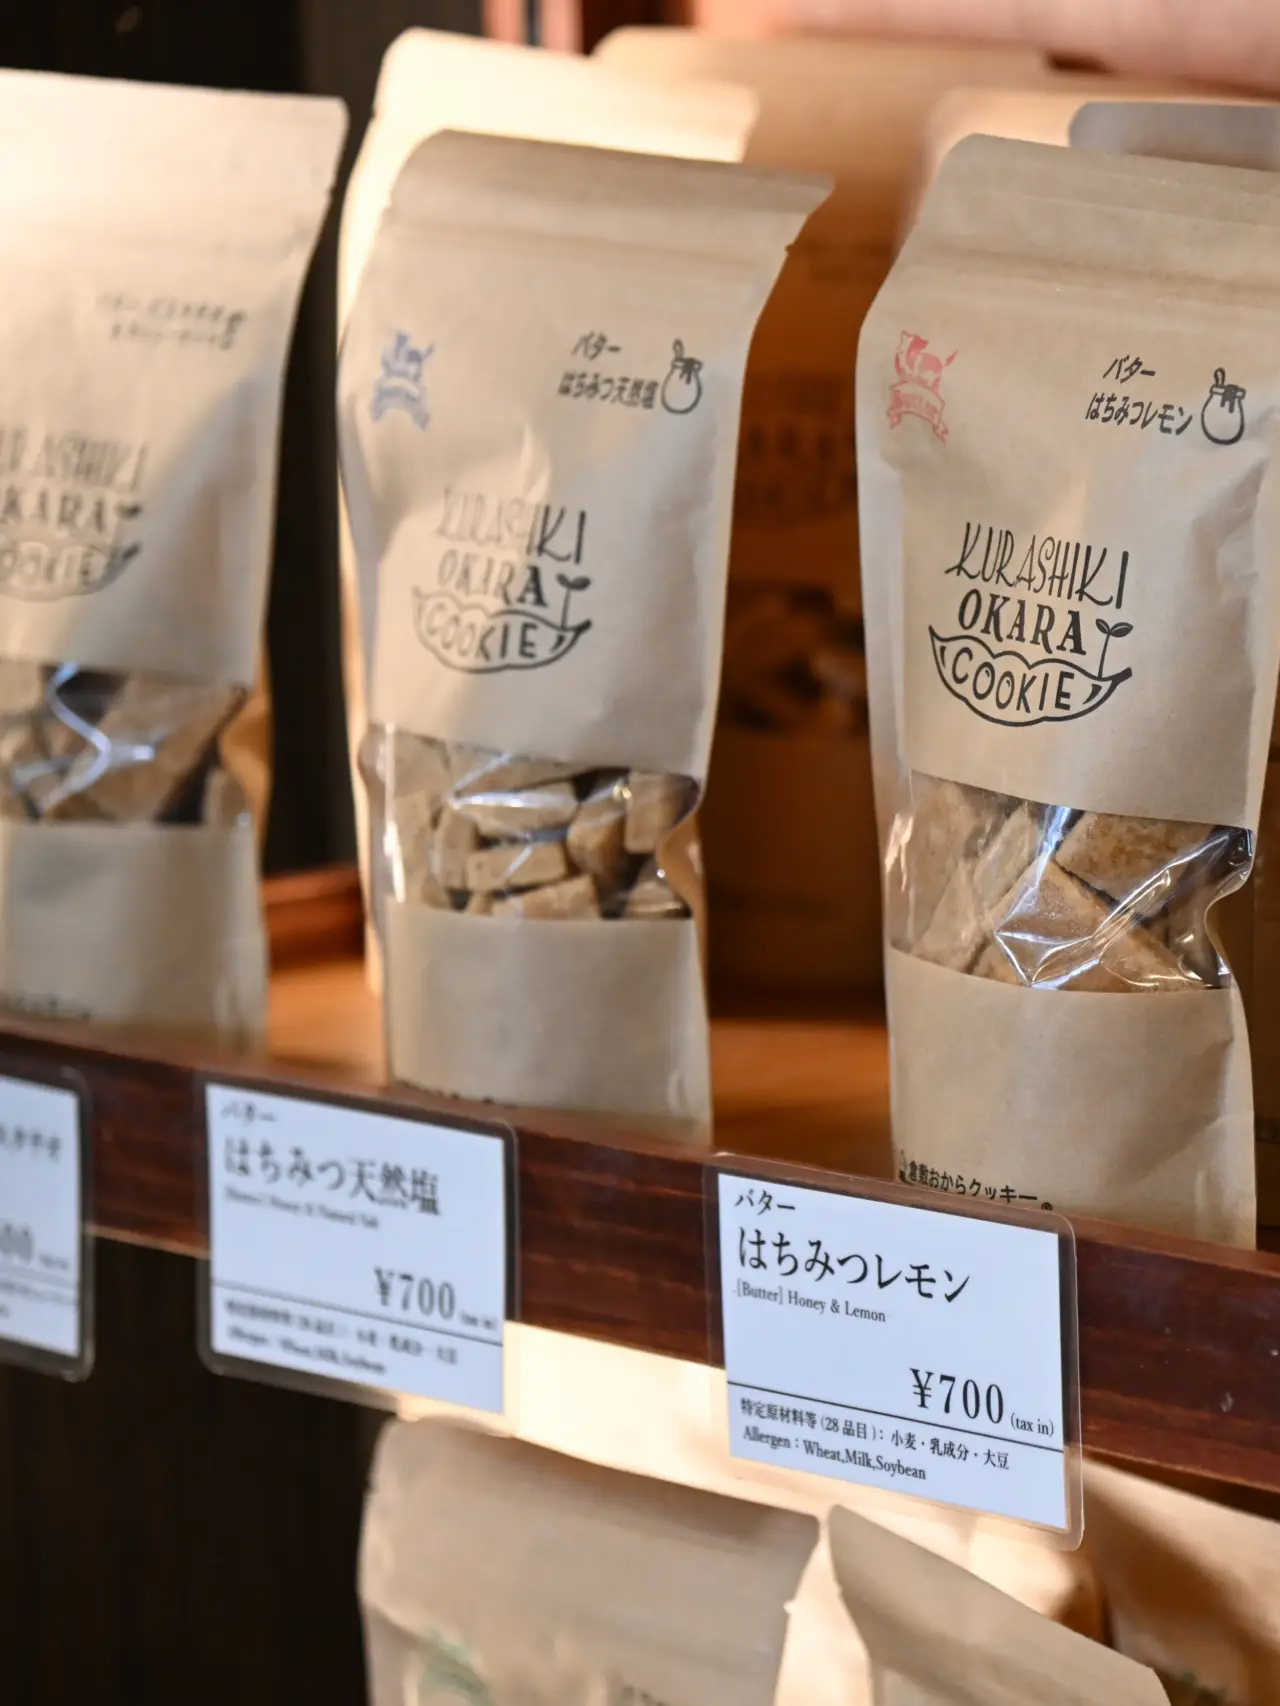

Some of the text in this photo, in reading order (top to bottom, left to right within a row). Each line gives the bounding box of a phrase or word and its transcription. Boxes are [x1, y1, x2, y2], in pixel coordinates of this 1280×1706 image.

[1103, 354, 1156, 384] バター
[1085, 391, 1194, 435] はちみつレモン
[945, 522, 1129, 609] KURASHIKI
[958, 589, 1087, 655] OKARA
[952, 647, 1074, 713] COOKIE
[734, 1189, 796, 1217] バター
[374, 1265, 456, 1321] ¥700
[738, 1226, 970, 1304] はちみつレモン
[737, 1278, 886, 1322] [Butter] Honey & Lemon
[909, 1367, 1054, 1438] ¥700 (tax in)
[743, 1425, 791, 1450] Allergen
